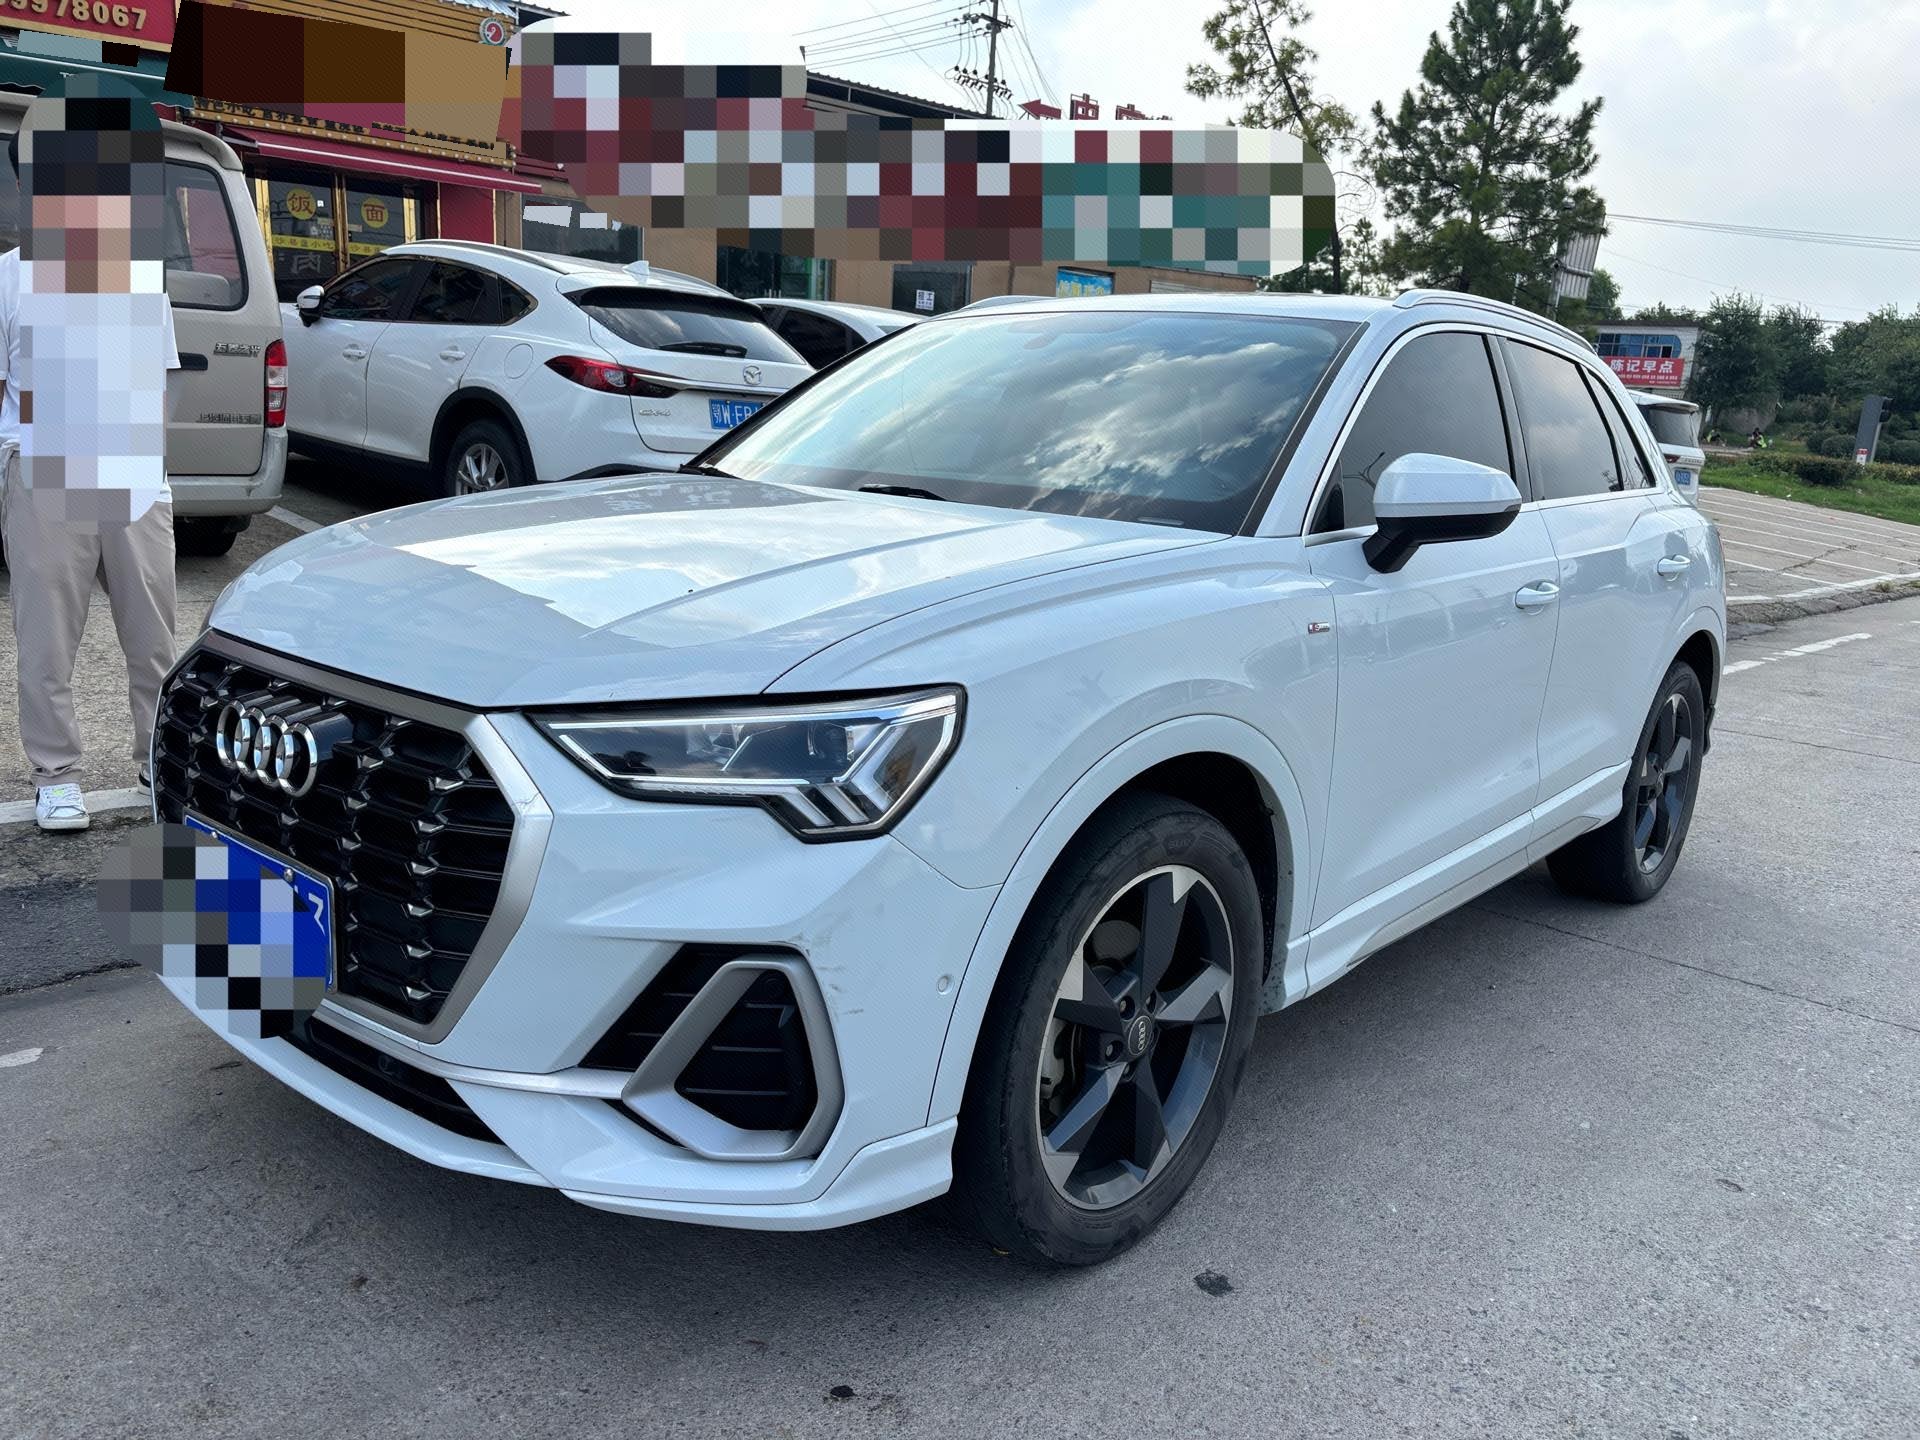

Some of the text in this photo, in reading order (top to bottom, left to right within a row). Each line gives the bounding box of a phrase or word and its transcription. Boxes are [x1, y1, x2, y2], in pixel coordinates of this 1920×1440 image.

[288, 193, 314, 215] 饭
[363, 203, 386, 223] 面
[1610, 359, 1674, 374] 陈记早点
